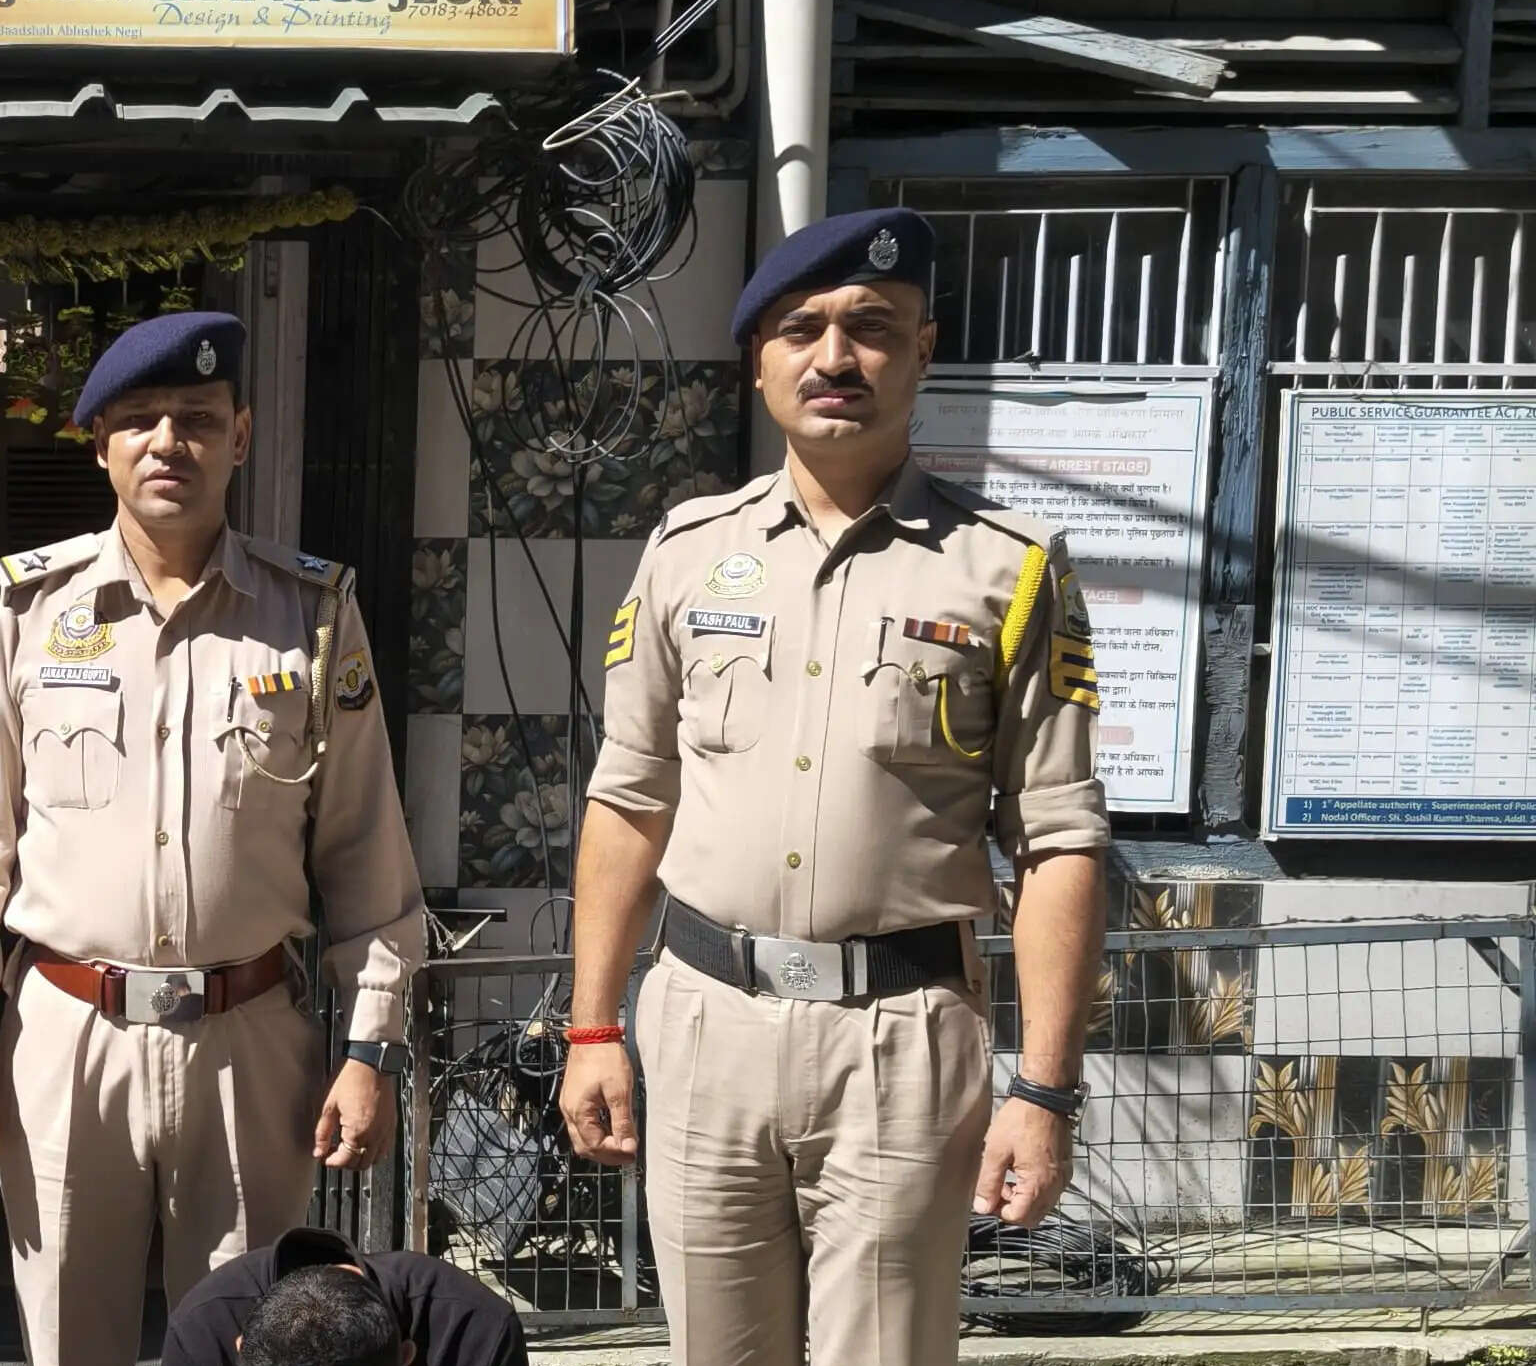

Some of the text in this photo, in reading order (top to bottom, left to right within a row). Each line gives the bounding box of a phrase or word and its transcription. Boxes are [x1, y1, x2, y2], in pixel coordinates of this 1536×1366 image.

[152, 2, 391, 35] Design & Printing
[408, 3, 519, 21] 70183-48602
[115, 26, 143, 39] Negi
[1312, 406, 1356, 417] PUBLIC
[1360, 406, 1411, 418] SERVICE
[1414, 407, 1491, 418] GUARANTEE
[1495, 405, 1521, 420] ACT,
[1049, 459, 1100, 472] ARREST
[1103, 460, 1150, 475] STAGE)
[1082, 590, 1119, 603] TAGE)
[695, 612, 752, 630] YASH PAUL
[1334, 800, 1378, 811] Appellate
[1379, 800, 1422, 812] authority
[1431, 801, 1502, 811] Superintendent
[1503, 802, 1514, 810] of
[1321, 813, 1348, 822] Nodal
[1350, 813, 1381, 822] Officer
